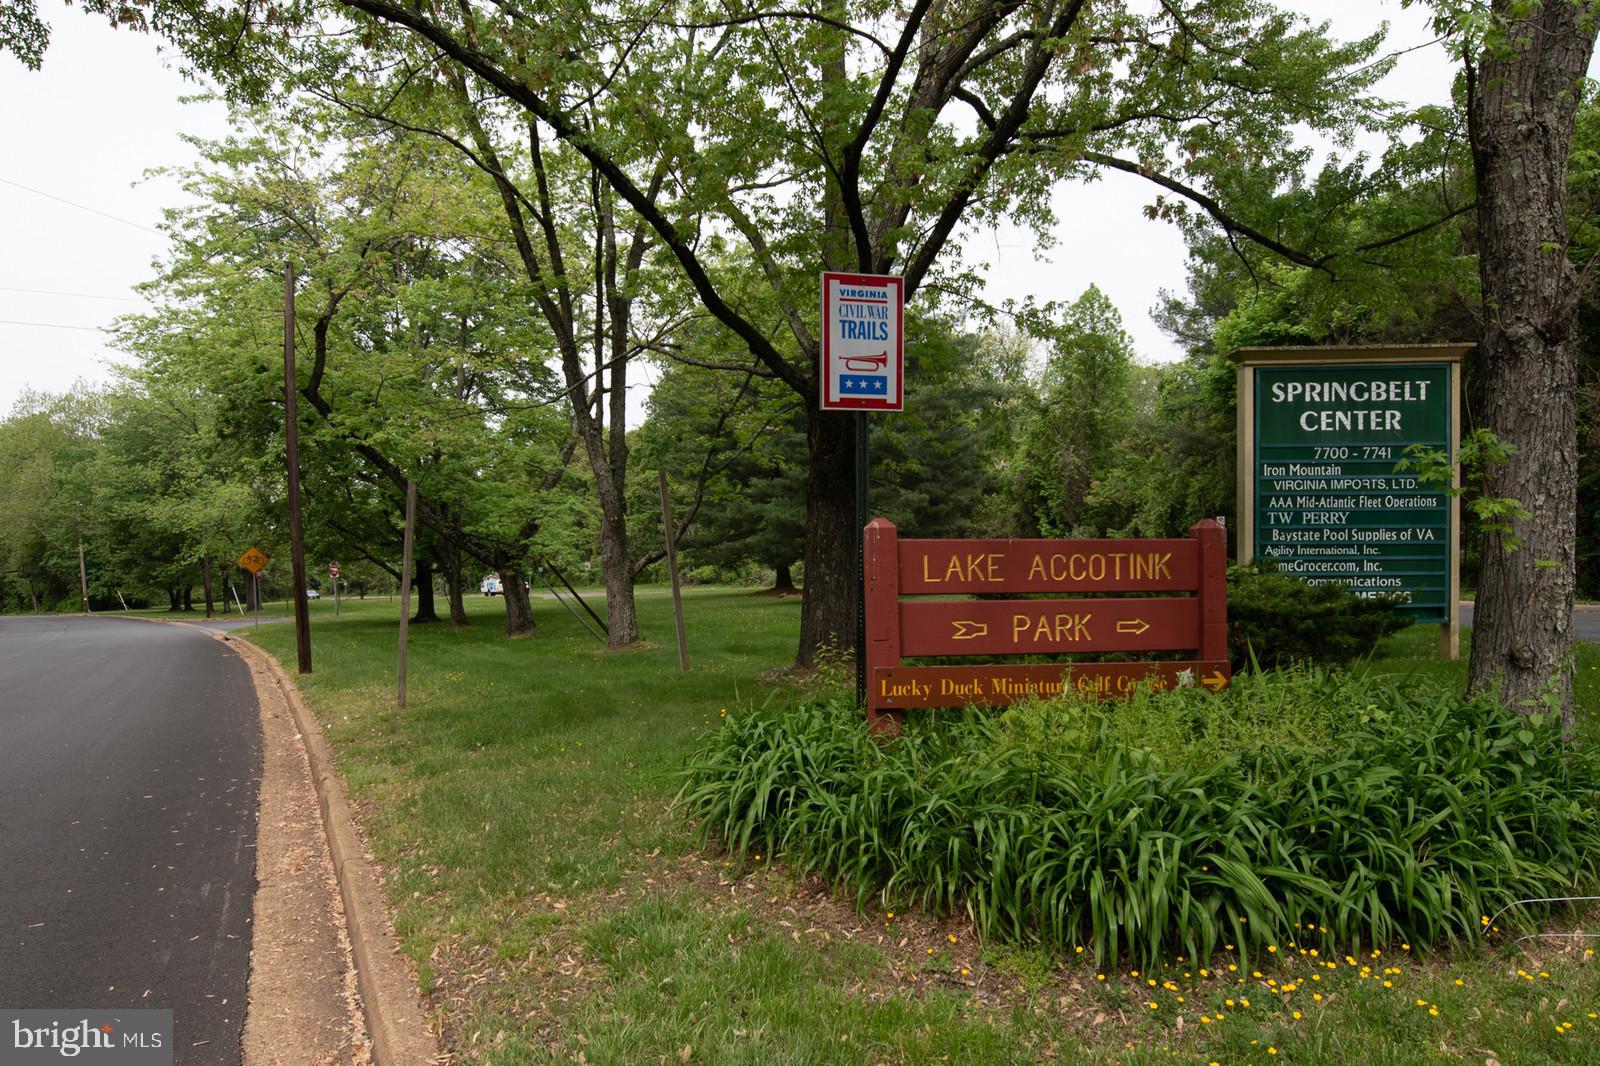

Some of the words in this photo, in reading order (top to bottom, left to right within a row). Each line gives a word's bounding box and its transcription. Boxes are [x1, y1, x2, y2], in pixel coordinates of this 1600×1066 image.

[839, 289, 888, 299] VIRGINIA
[839, 304, 866, 319] CIVIL
[867, 305, 888, 320] WAR
[839, 320, 888, 341] TRAILS
[1271, 380, 1431, 403] SPRINGBELT
[1299, 410, 1402, 432] CENTER
[1314, 447, 1349, 460] 7700
[1363, 447, 1392, 460] 7741
[1263, 464, 1286, 476] Iron
[1289, 463, 1342, 476] Mountain
[1273, 480, 1328, 491] VIRGINIA
[1330, 479, 1389, 492] IMPORTS,
[1392, 479, 1419, 490] LTD.
[1269, 497, 1294, 508] AAA
[1296, 496, 1356, 508] Mid-Atlantic
[1359, 496, 1382, 508] Fleet
[1385, 495, 1437, 508] Operations
[1267, 512, 1294, 524] TW
[1302, 511, 1350, 524] PERRY
[1272, 528, 1320, 542] Baystate
[1323, 528, 1349, 541] Pool
[1352, 528, 1397, 542] Supplies
[1400, 528, 1413, 541] of
[1416, 528, 1435, 541] VA
[1264, 545, 1295, 557] Agility
[1297, 544, 1360, 556] International,
[1363, 544, 1381, 555] Inc.
[923, 554, 1006, 583] LAKE
[1028, 552, 1173, 581] ACCOTINK
[1363, 559, 1383, 572] Inc.
[1013, 613, 1093, 643] PARK
[880, 679, 933, 701] Lucky
[940, 678, 984, 696] Duck
[991, 677, 1068, 695] Miniatur
[1117, 674, 1168, 694] Corse
